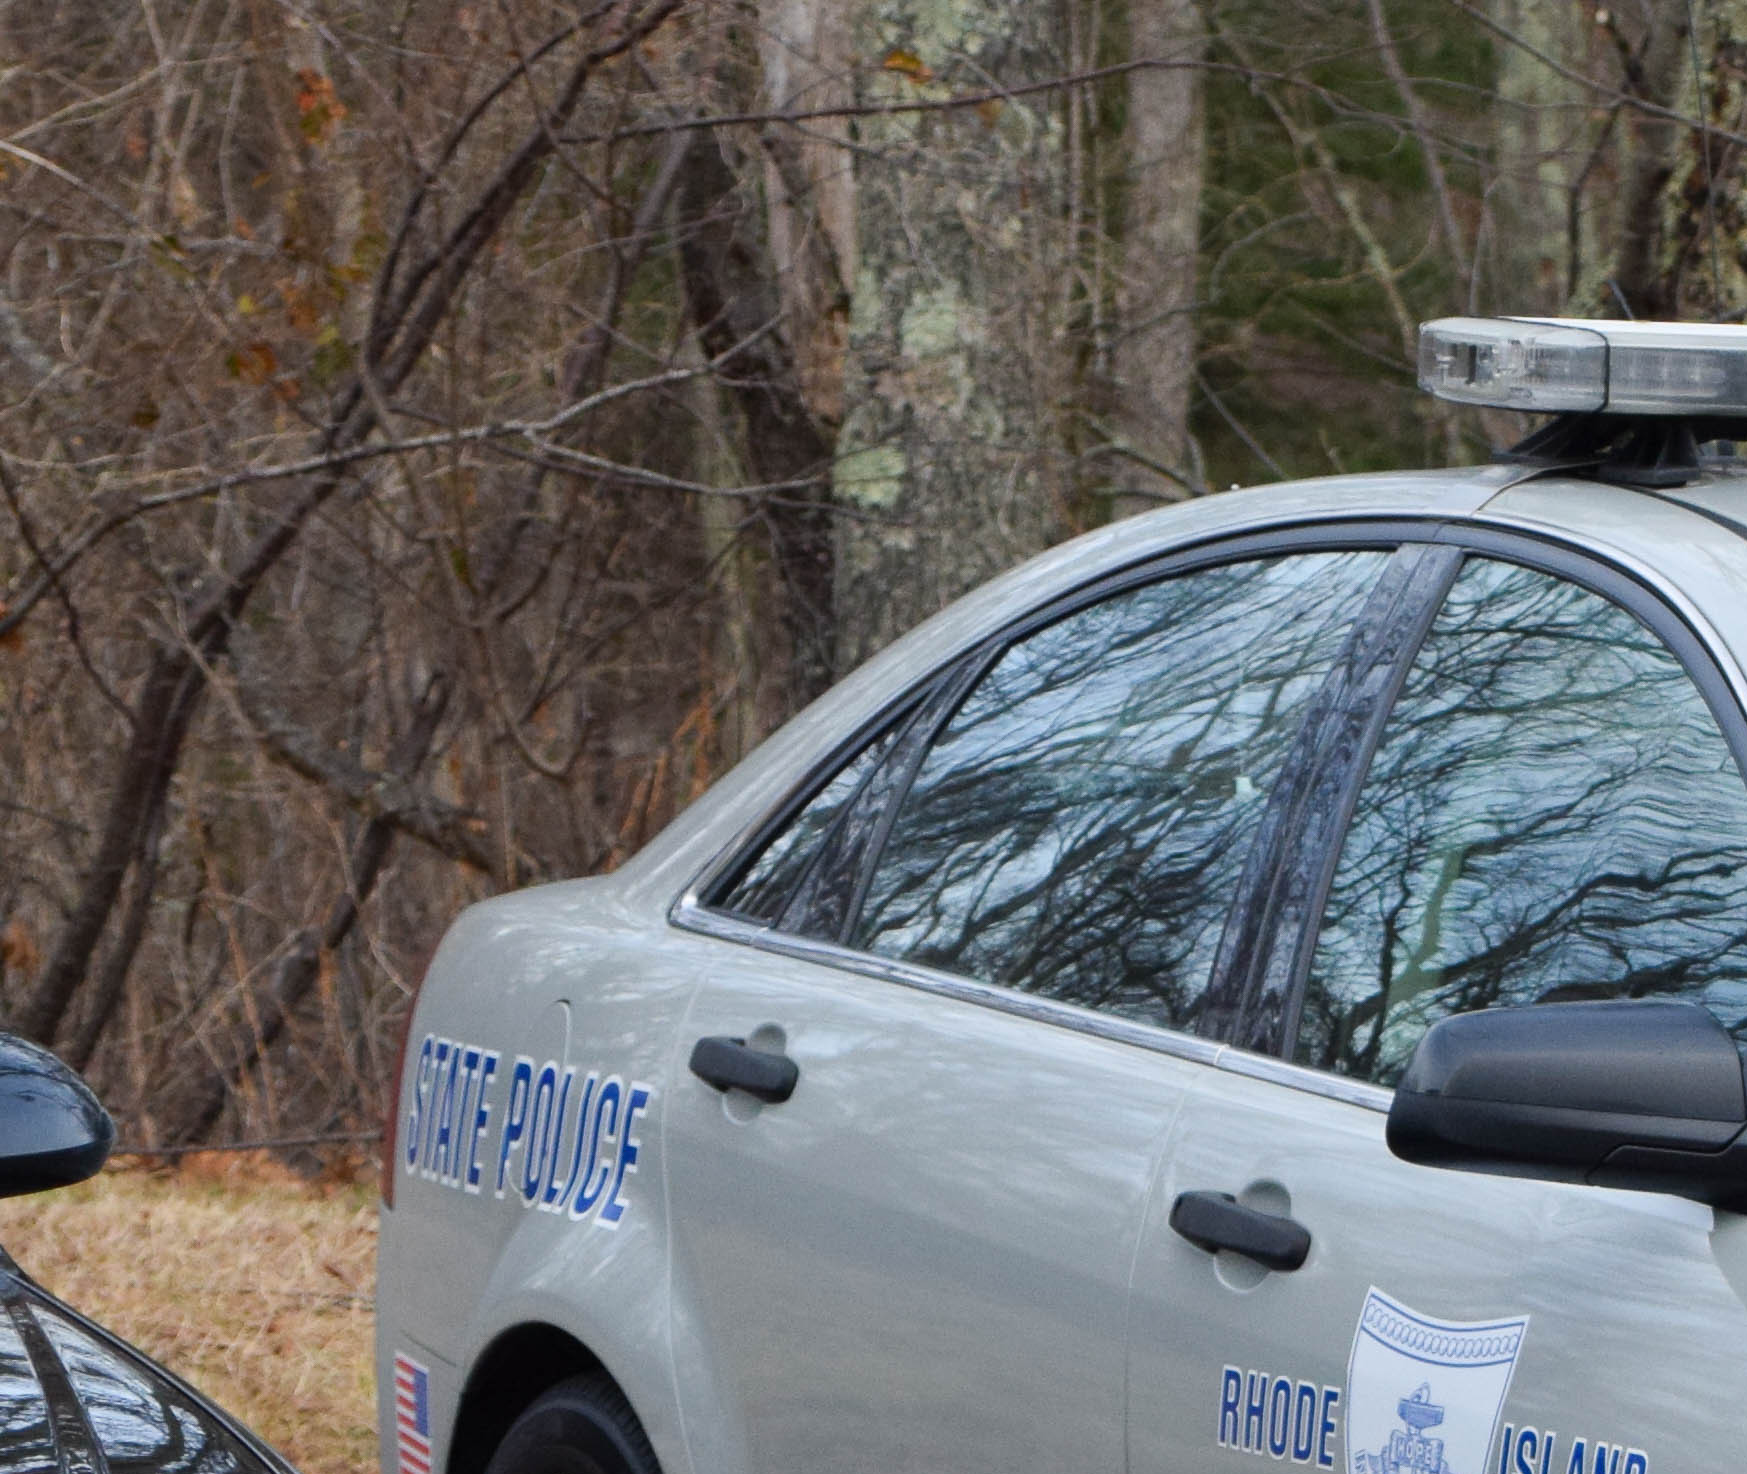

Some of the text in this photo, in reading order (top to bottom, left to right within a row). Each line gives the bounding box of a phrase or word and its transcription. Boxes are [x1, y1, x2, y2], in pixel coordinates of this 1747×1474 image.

[405, 1032, 654, 1231] STATE POLICE
[1217, 1364, 1341, 1471] RHODE
